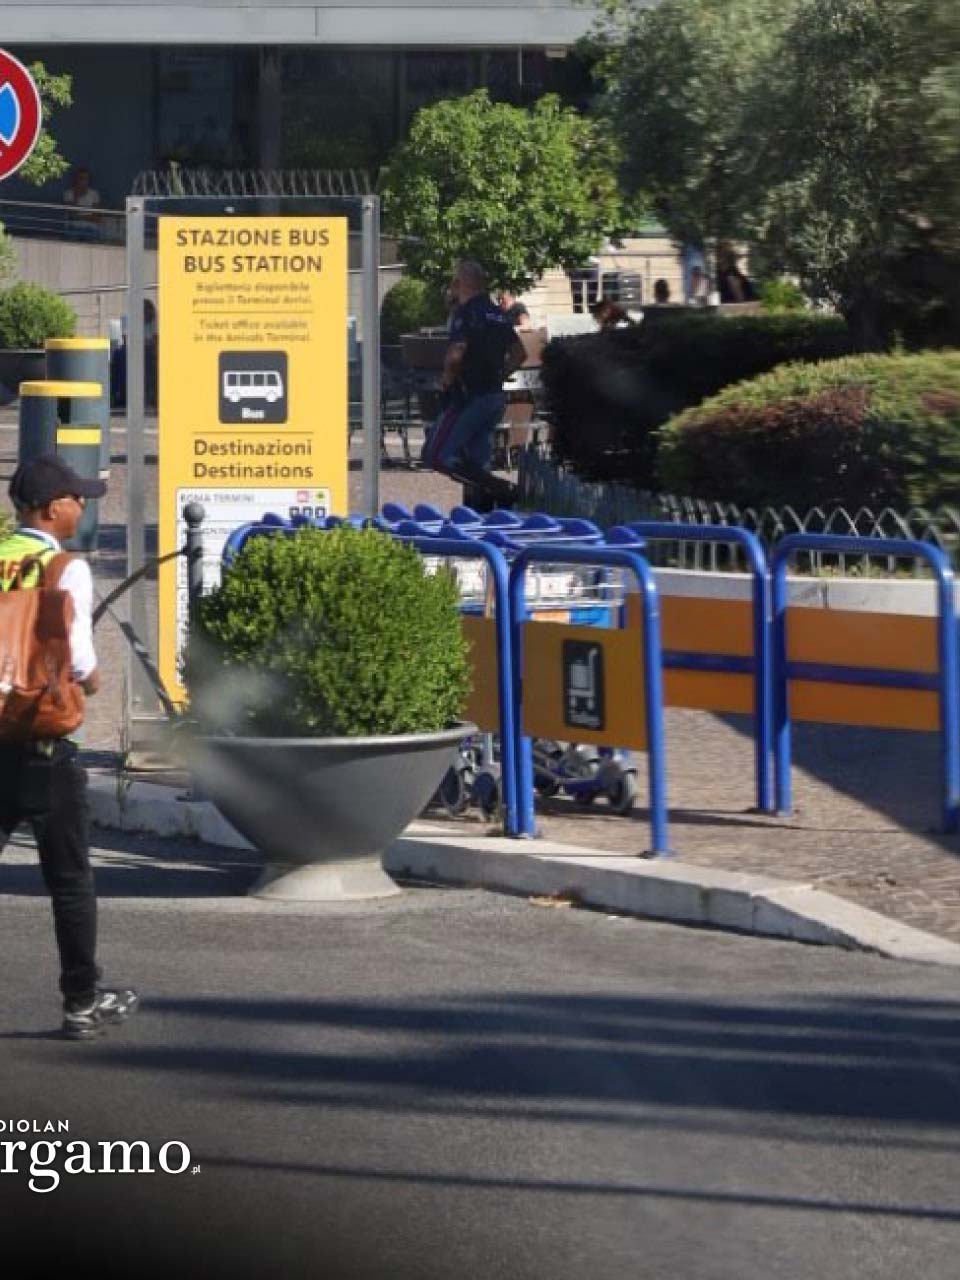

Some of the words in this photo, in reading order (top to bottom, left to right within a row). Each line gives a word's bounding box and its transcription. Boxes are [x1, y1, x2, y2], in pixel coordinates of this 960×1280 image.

[176, 229, 282, 247] STAZIONE
[288, 229, 330, 247] BUS
[184, 255, 226, 273] BUS
[232, 255, 322, 273] STATION
[241, 407, 265, 419] Bus
[194, 439, 313, 456] Destinazioni
[193, 462, 314, 478] Destinations
